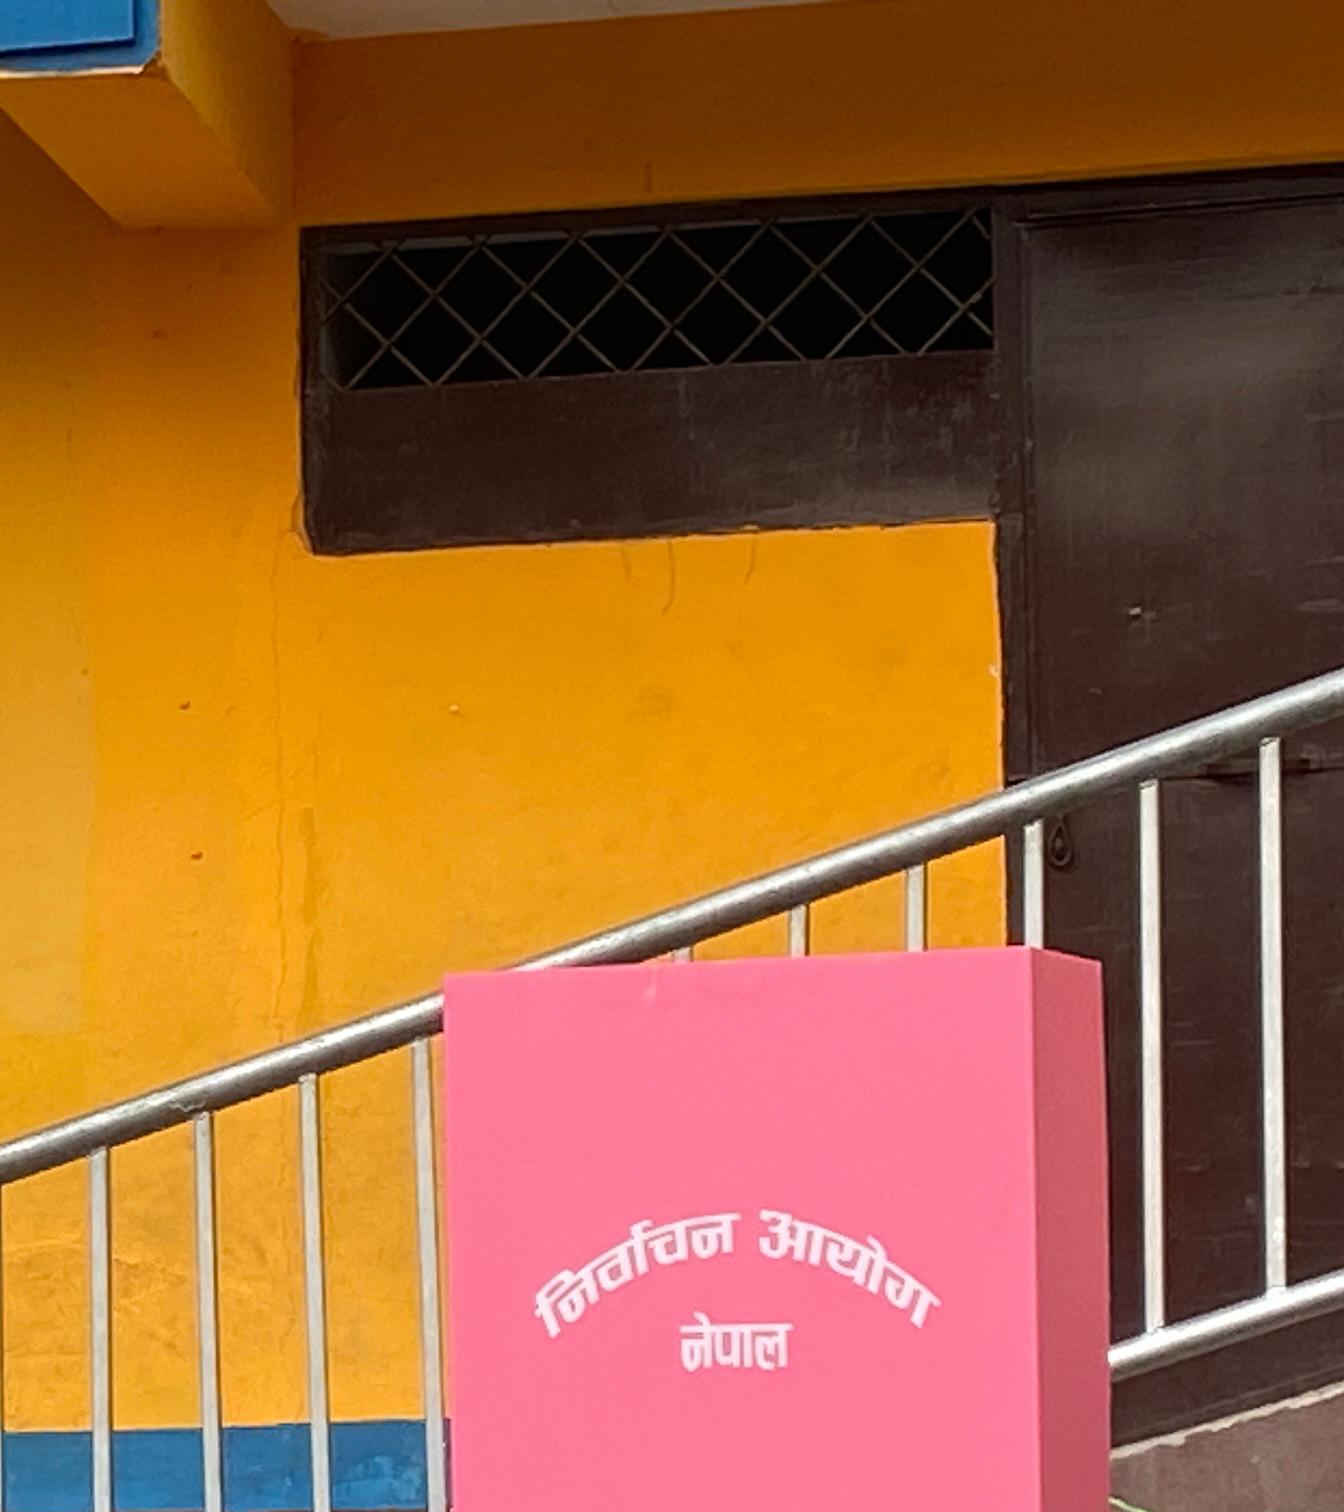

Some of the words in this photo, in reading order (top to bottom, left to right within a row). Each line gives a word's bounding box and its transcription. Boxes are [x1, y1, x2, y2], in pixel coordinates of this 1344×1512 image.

[534, 1212, 741, 1338] निर्वाचन
[759, 1208, 941, 1329] आयोग
[679, 1311, 793, 1372] नेपाल
